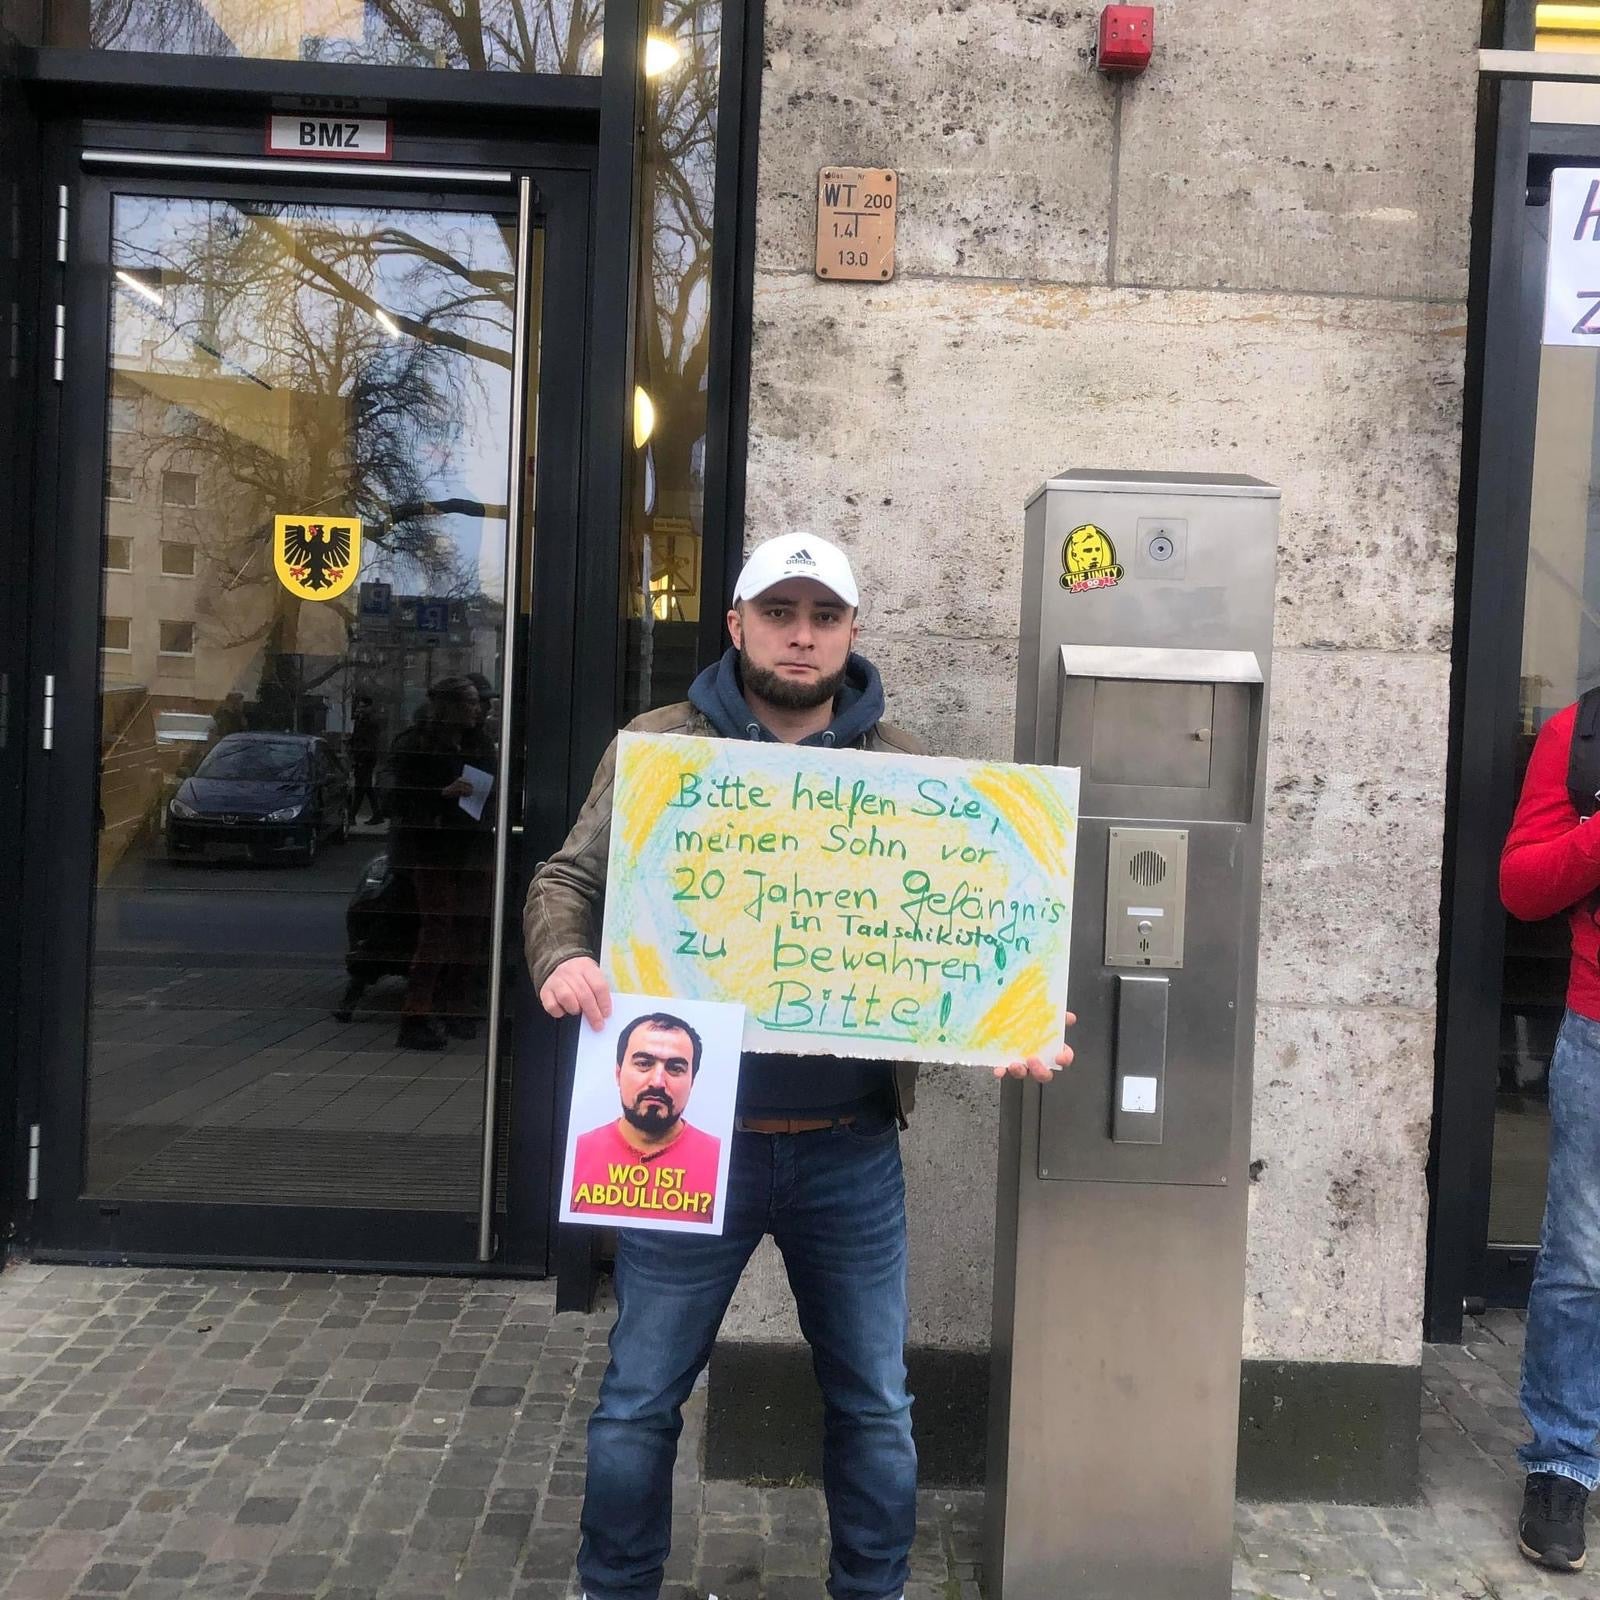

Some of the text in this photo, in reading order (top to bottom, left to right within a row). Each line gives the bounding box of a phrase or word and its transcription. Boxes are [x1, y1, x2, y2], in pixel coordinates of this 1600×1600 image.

[299, 121, 361, 148] BMZ
[824, 183, 893, 209] WT 200
[786, 557, 817, 567] adidas
[1065, 567, 1118, 587] THE UNITY
[666, 772, 771, 811] Bitte
[792, 771, 897, 828] helfen
[675, 821, 999, 863] meinen Sohn vor
[672, 867, 725, 901] 20
[743, 871, 877, 923] Jahren
[789, 911, 821, 932] in
[675, 930, 728, 960] zu
[608, 1163, 687, 1189] WO IST
[573, 1183, 713, 1214] ABDULLOH?
